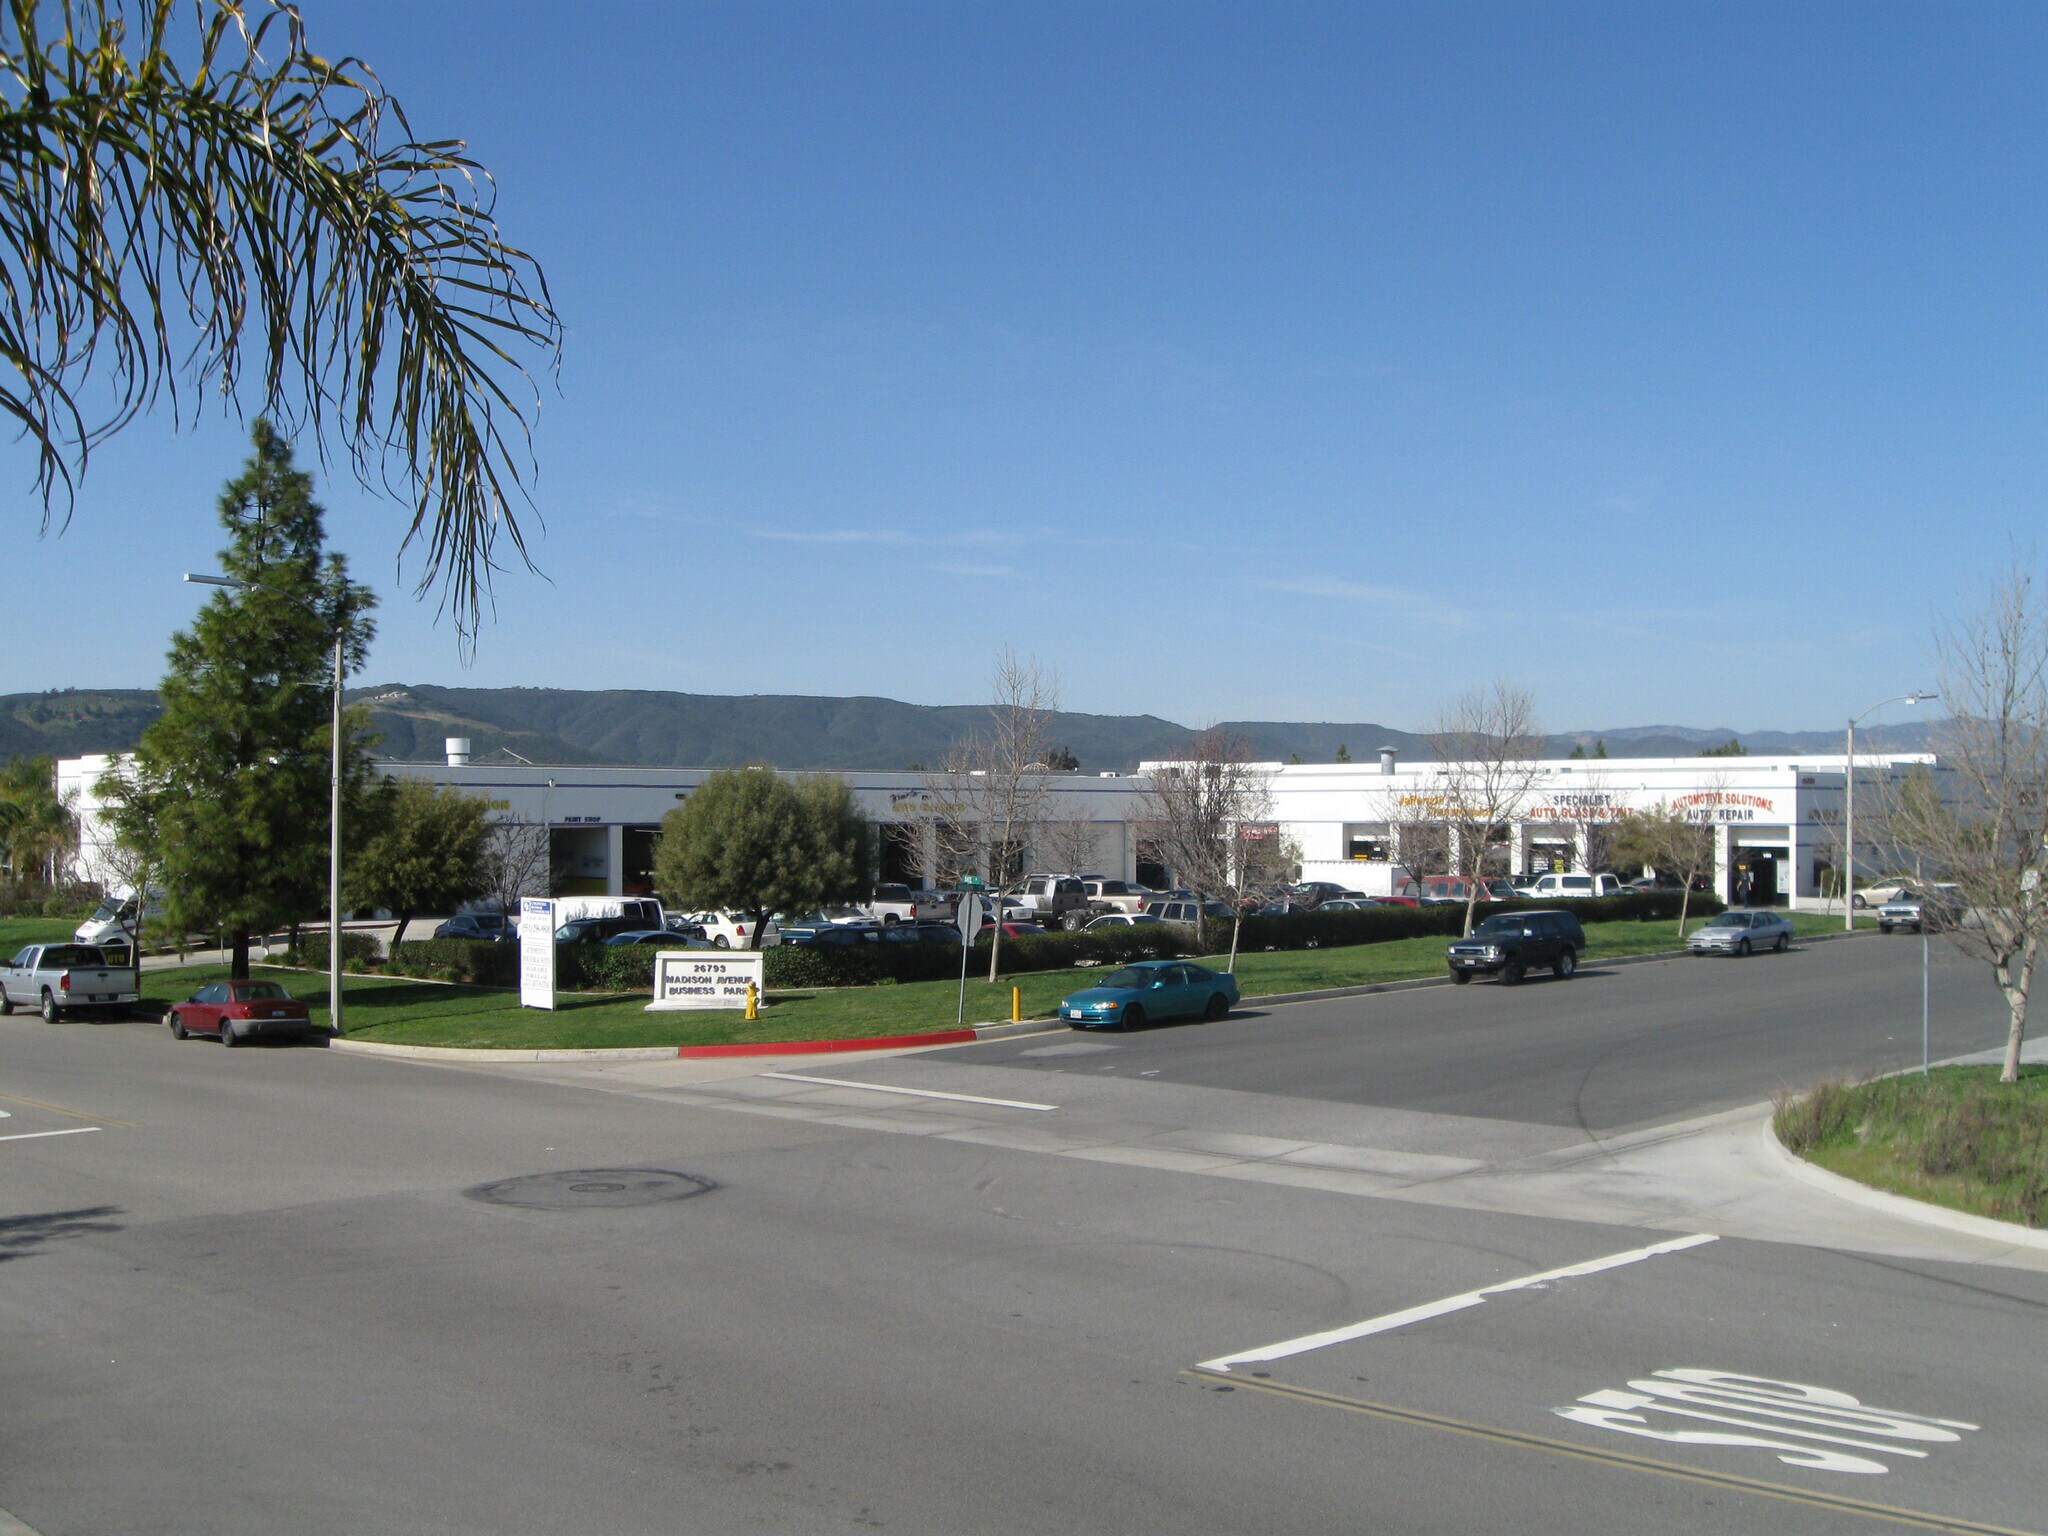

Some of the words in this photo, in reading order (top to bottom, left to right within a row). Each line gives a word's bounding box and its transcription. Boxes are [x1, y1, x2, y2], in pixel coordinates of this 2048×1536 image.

[1553, 794, 1611, 806] SPECIALIST
[1672, 792, 1723, 811] AUTOMOTIVE
[1725, 792, 1774, 811] SOLUTIONS
[1529, 807, 1557, 819] AUTO
[1609, 807, 1634, 818] TINT
[1687, 809, 1712, 821] AUTO
[1719, 809, 1754, 821] REPAIR
[693, 964, 727, 974] 26793
[665, 975, 713, 985] MADISON
[716, 976, 753, 985] AVENUE
[669, 986, 716, 996] BUSINESS
[1552, 1367, 1981, 1474] STOP
